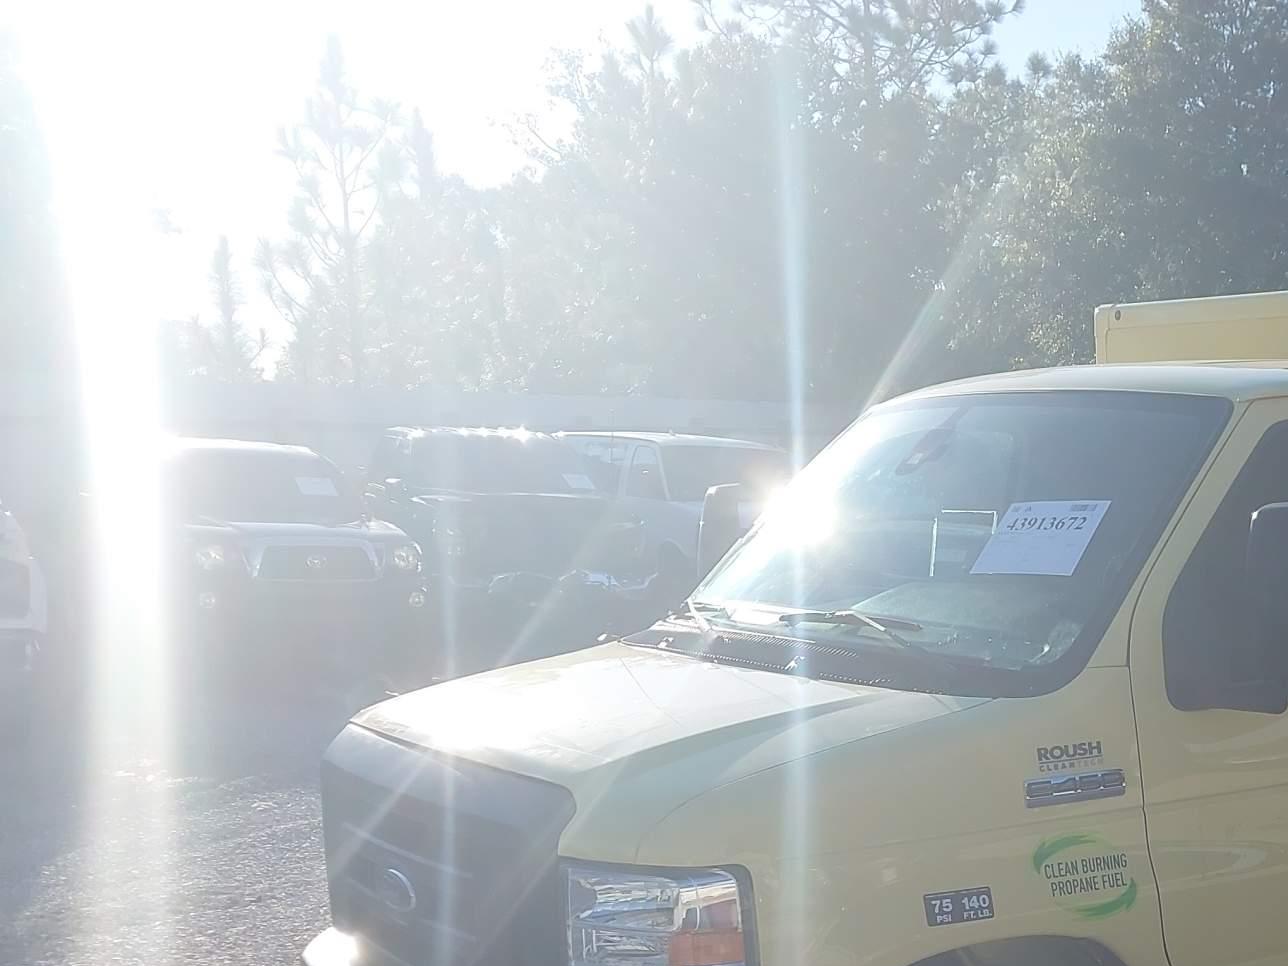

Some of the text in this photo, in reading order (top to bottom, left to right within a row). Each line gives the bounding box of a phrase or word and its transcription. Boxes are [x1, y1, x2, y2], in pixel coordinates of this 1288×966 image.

[1006, 516, 1088, 531] 43913672
[1037, 741, 1102, 761] ROUSH
[1044, 853, 1128, 879] CLEAN BURNING
[1050, 872, 1128, 897] PROPANE FUEL
[930, 894, 990, 914] 75 140
[936, 914, 952, 924] PSI
